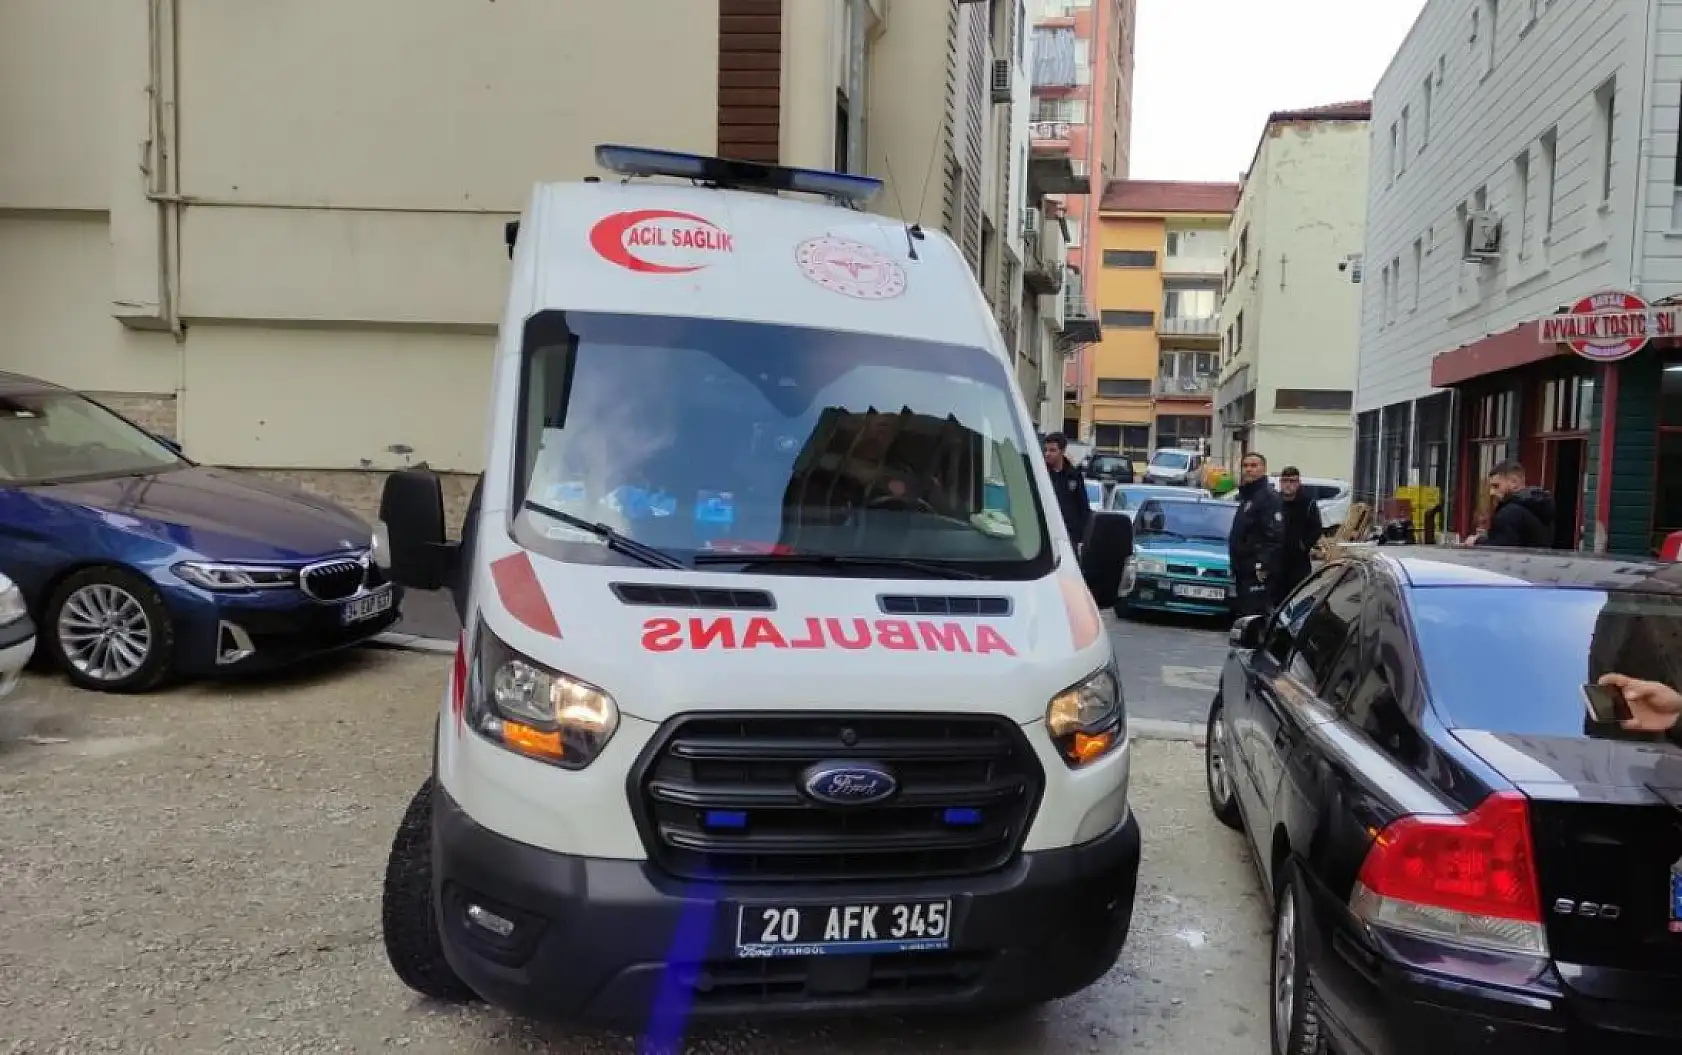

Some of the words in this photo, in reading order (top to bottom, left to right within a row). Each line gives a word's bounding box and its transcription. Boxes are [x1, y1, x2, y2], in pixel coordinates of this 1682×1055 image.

[1543, 315, 1597, 341] AYVALIK
[828, 774, 878, 796] Ford
[761, 908, 799, 942] 20
[823, 906, 879, 940] AFK
[890, 903, 945, 938] 345
